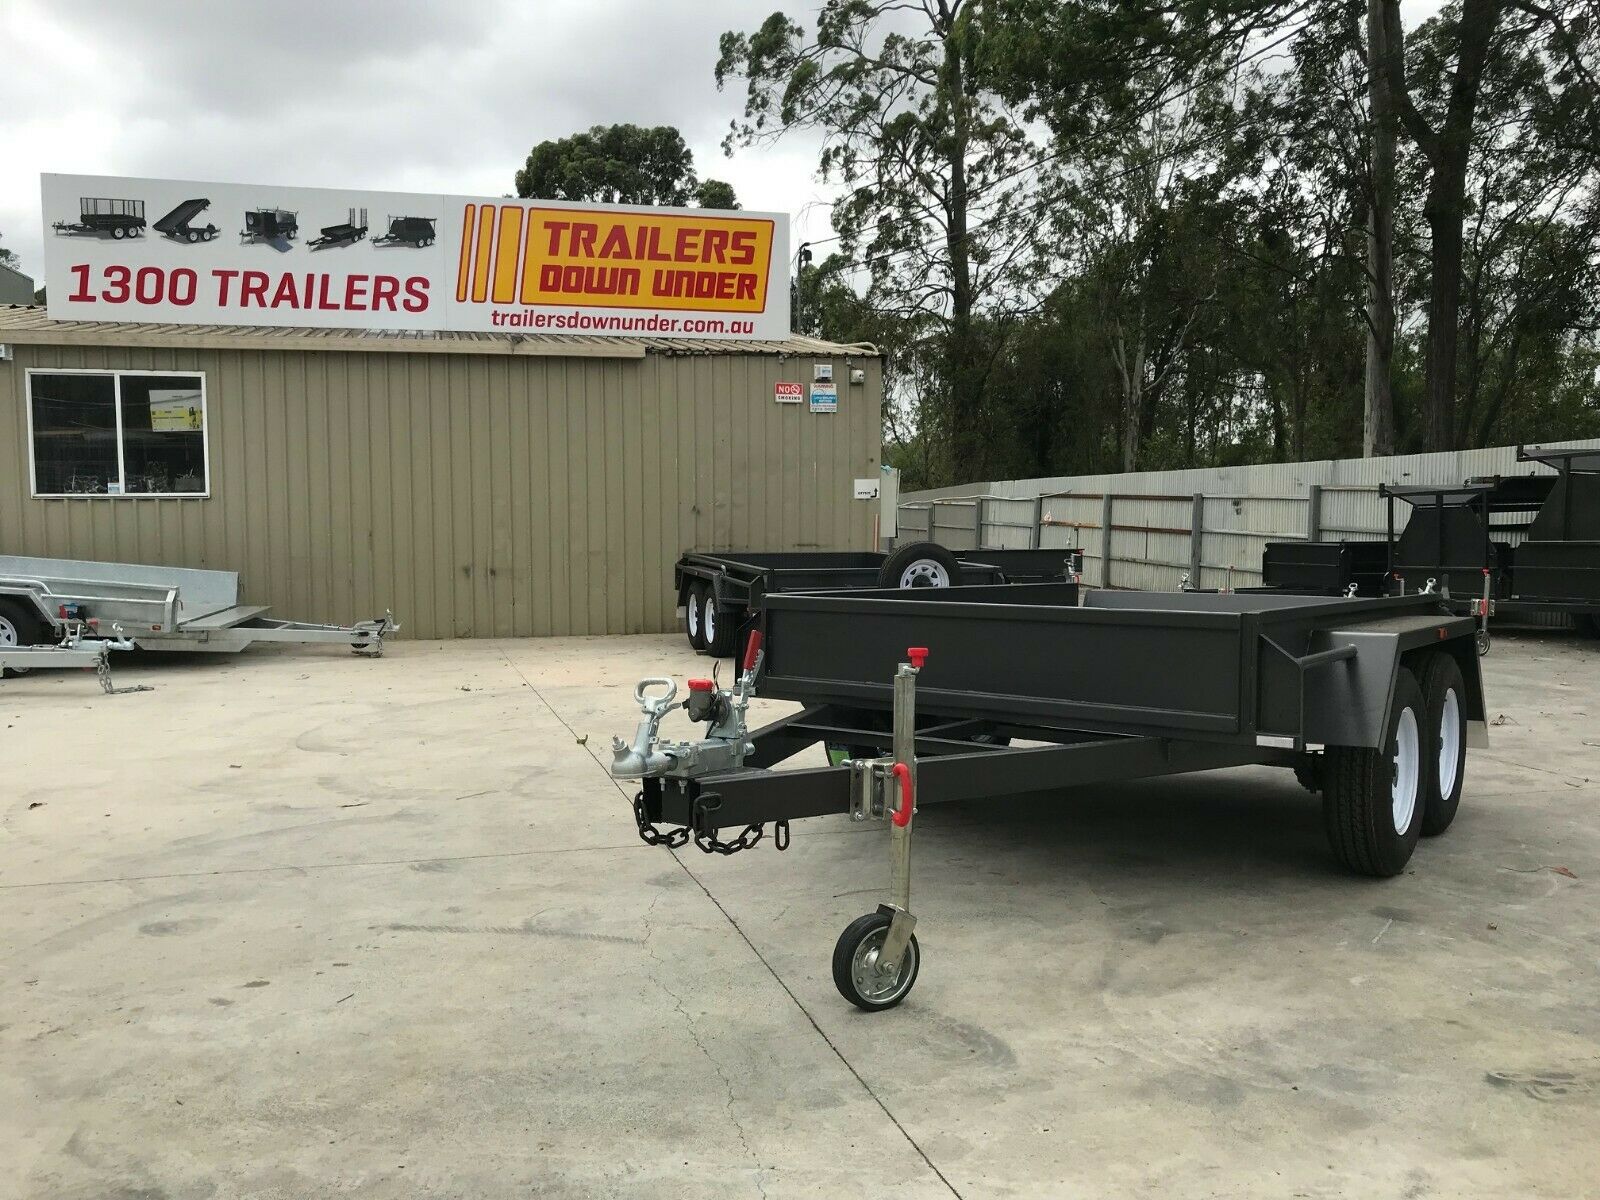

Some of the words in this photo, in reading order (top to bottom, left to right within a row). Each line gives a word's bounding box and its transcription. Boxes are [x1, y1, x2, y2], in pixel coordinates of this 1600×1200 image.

[543, 220, 758, 265] TRAILERS
[69, 264, 198, 305] 1300
[212, 270, 430, 313] TRAILERS
[539, 264, 641, 295] DOWN
[652, 269, 758, 300] UNDER
[491, 309, 754, 334] trailersdownunder.com.au
[778, 385, 790, 394] NO
